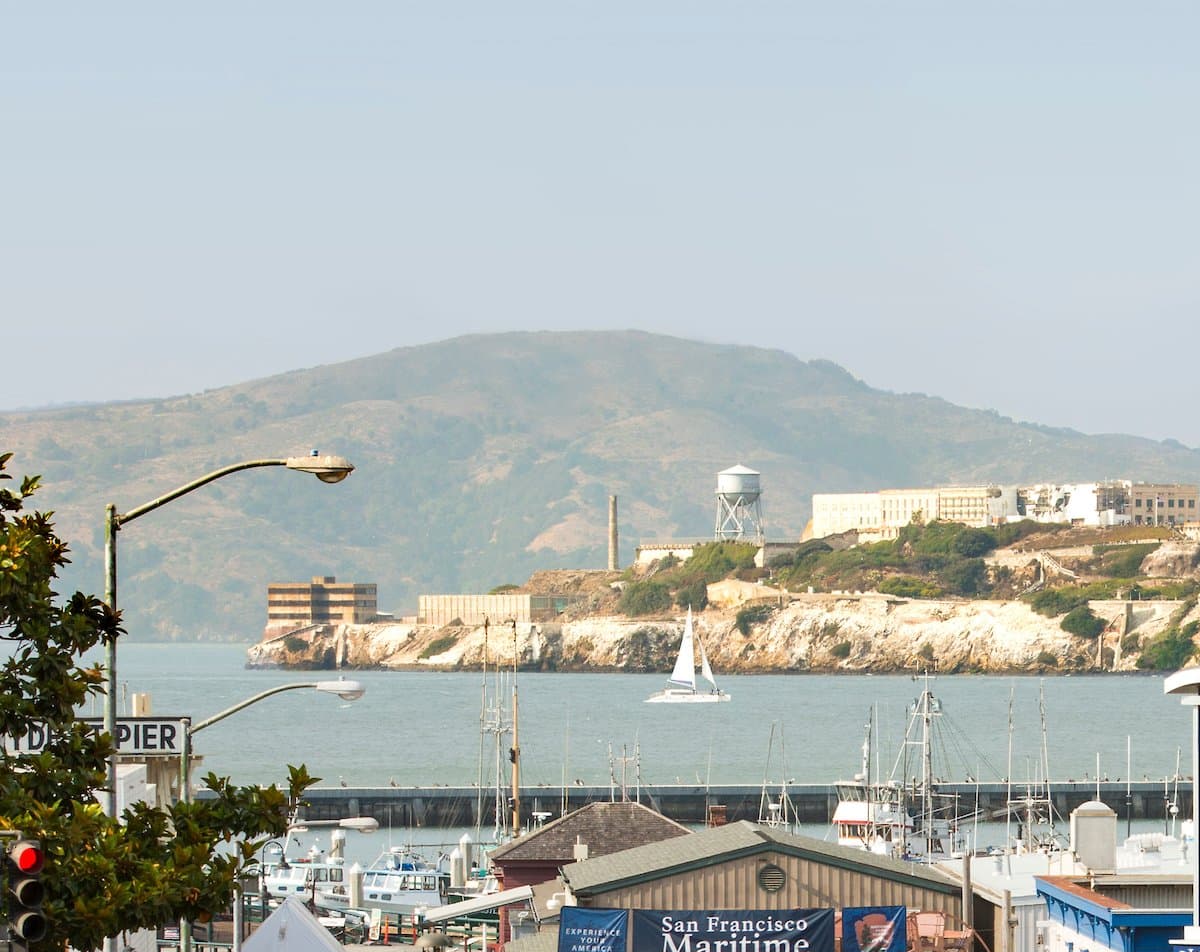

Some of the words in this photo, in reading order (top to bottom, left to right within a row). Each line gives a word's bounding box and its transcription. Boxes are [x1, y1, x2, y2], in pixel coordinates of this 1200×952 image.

[116, 724, 176, 750] PIER
[661, 916, 699, 932] San
[706, 916, 808, 932] Francisco
[565, 928, 621, 937] EXPERIENCE
[580, 937, 605, 945] YOUR
[571, 945, 613, 952] AMERICA
